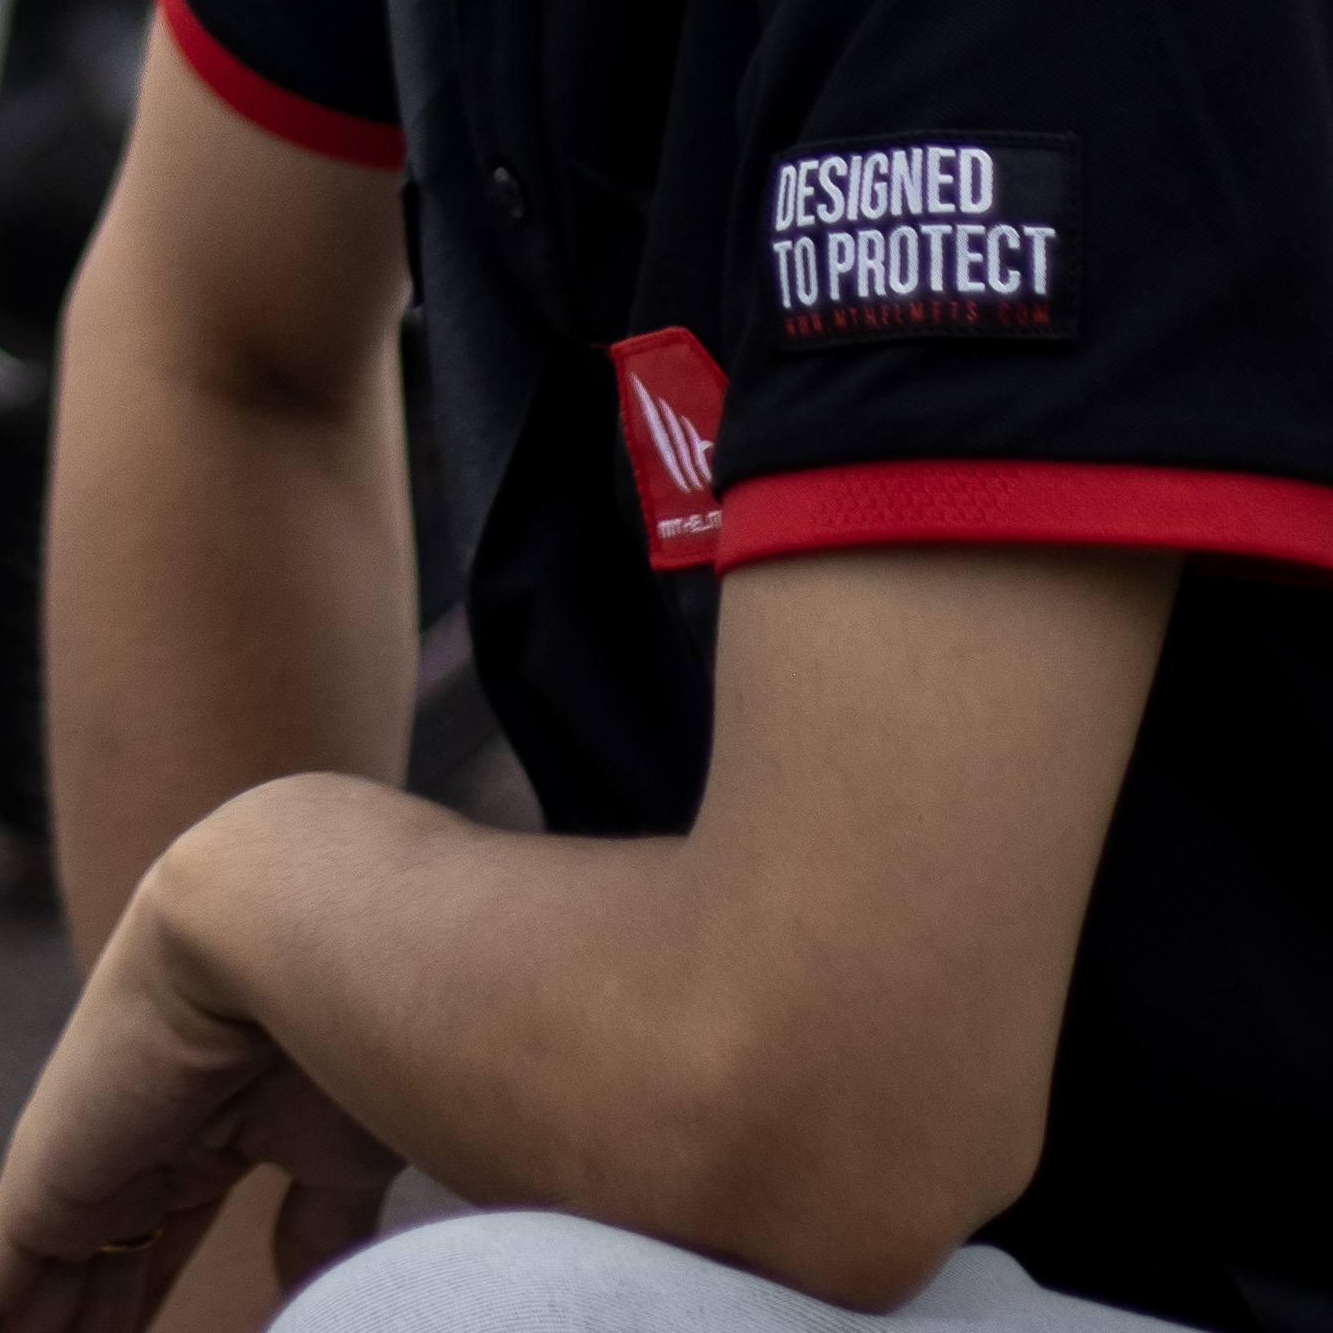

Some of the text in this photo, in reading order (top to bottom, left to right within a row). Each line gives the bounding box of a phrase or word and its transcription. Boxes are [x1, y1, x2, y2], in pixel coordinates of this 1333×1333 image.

[775, 144, 995, 232] DESIGNED
[772, 223, 1058, 309] TO PROTECT
